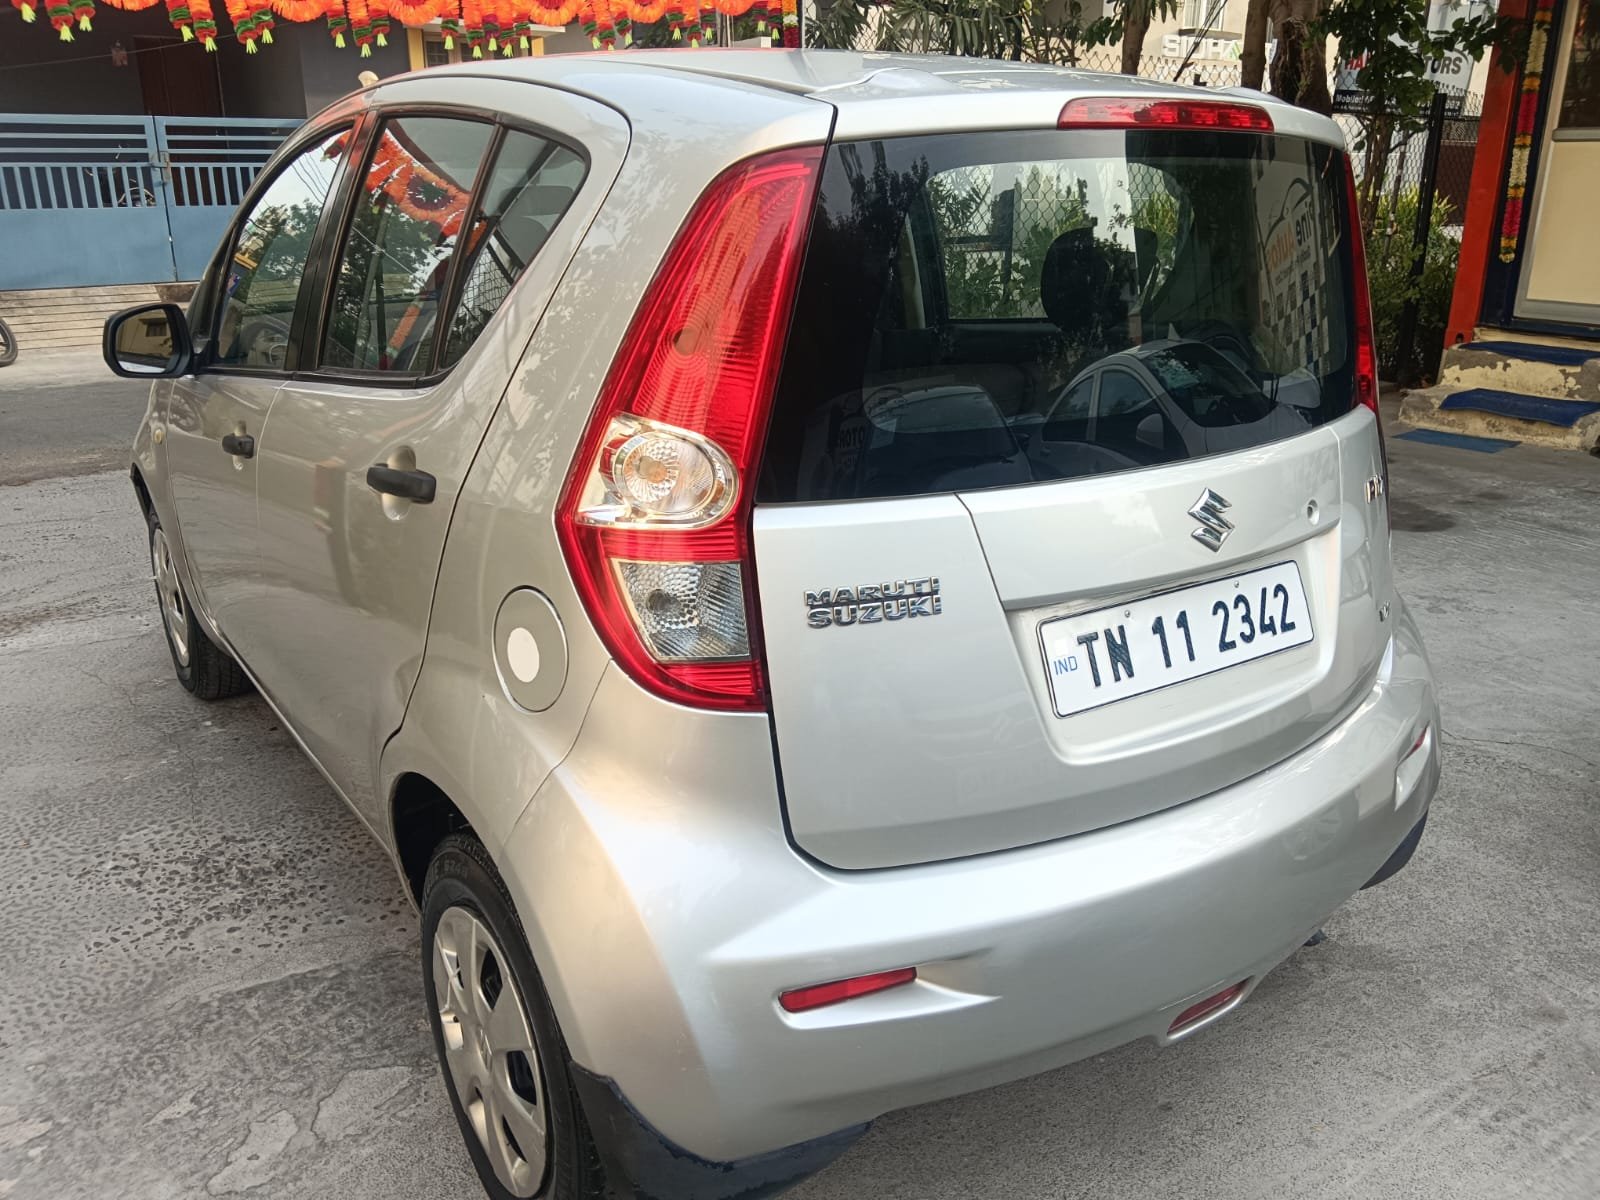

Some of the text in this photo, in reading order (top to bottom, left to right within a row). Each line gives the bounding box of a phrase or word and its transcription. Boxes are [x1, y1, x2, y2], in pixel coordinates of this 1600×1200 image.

[804, 575, 940, 607] MARUTI
[807, 594, 942, 630] SUZUKI
[1076, 582, 1297, 688] TN 11 2342
[1053, 655, 1079, 677] IND
